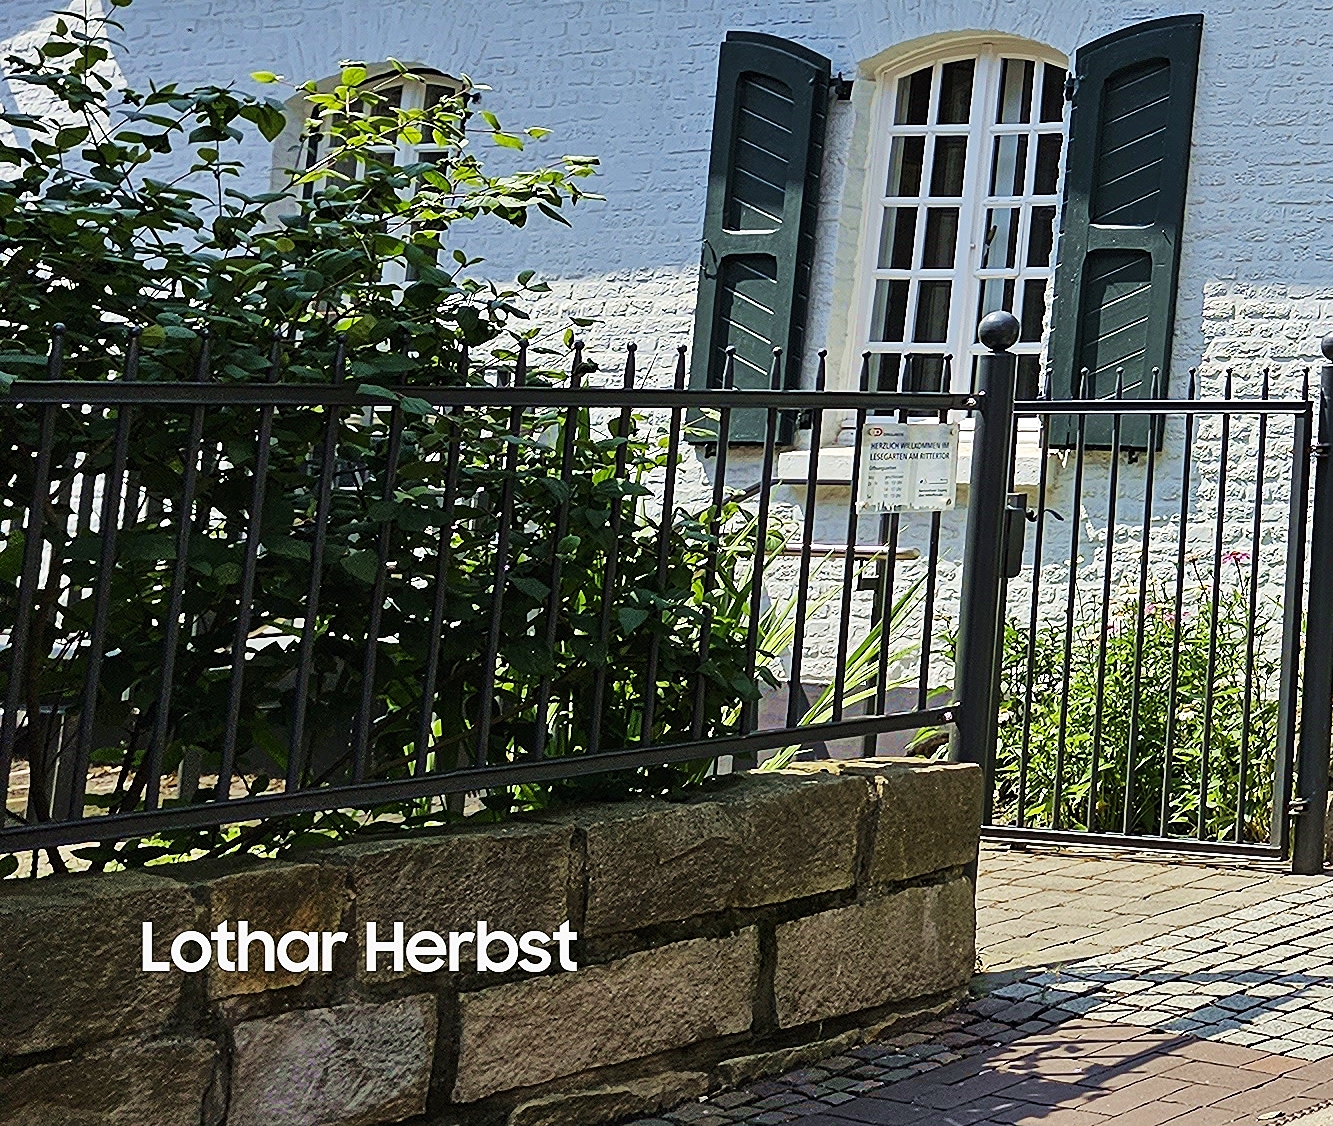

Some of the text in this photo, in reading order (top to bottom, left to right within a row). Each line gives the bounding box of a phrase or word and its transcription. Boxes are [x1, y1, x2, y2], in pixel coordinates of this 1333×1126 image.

[870, 441, 950, 450] HERZLICH WILLKOMMEN IM
[869, 452, 950, 461] LESEGARTEN AM RITTERTOR
